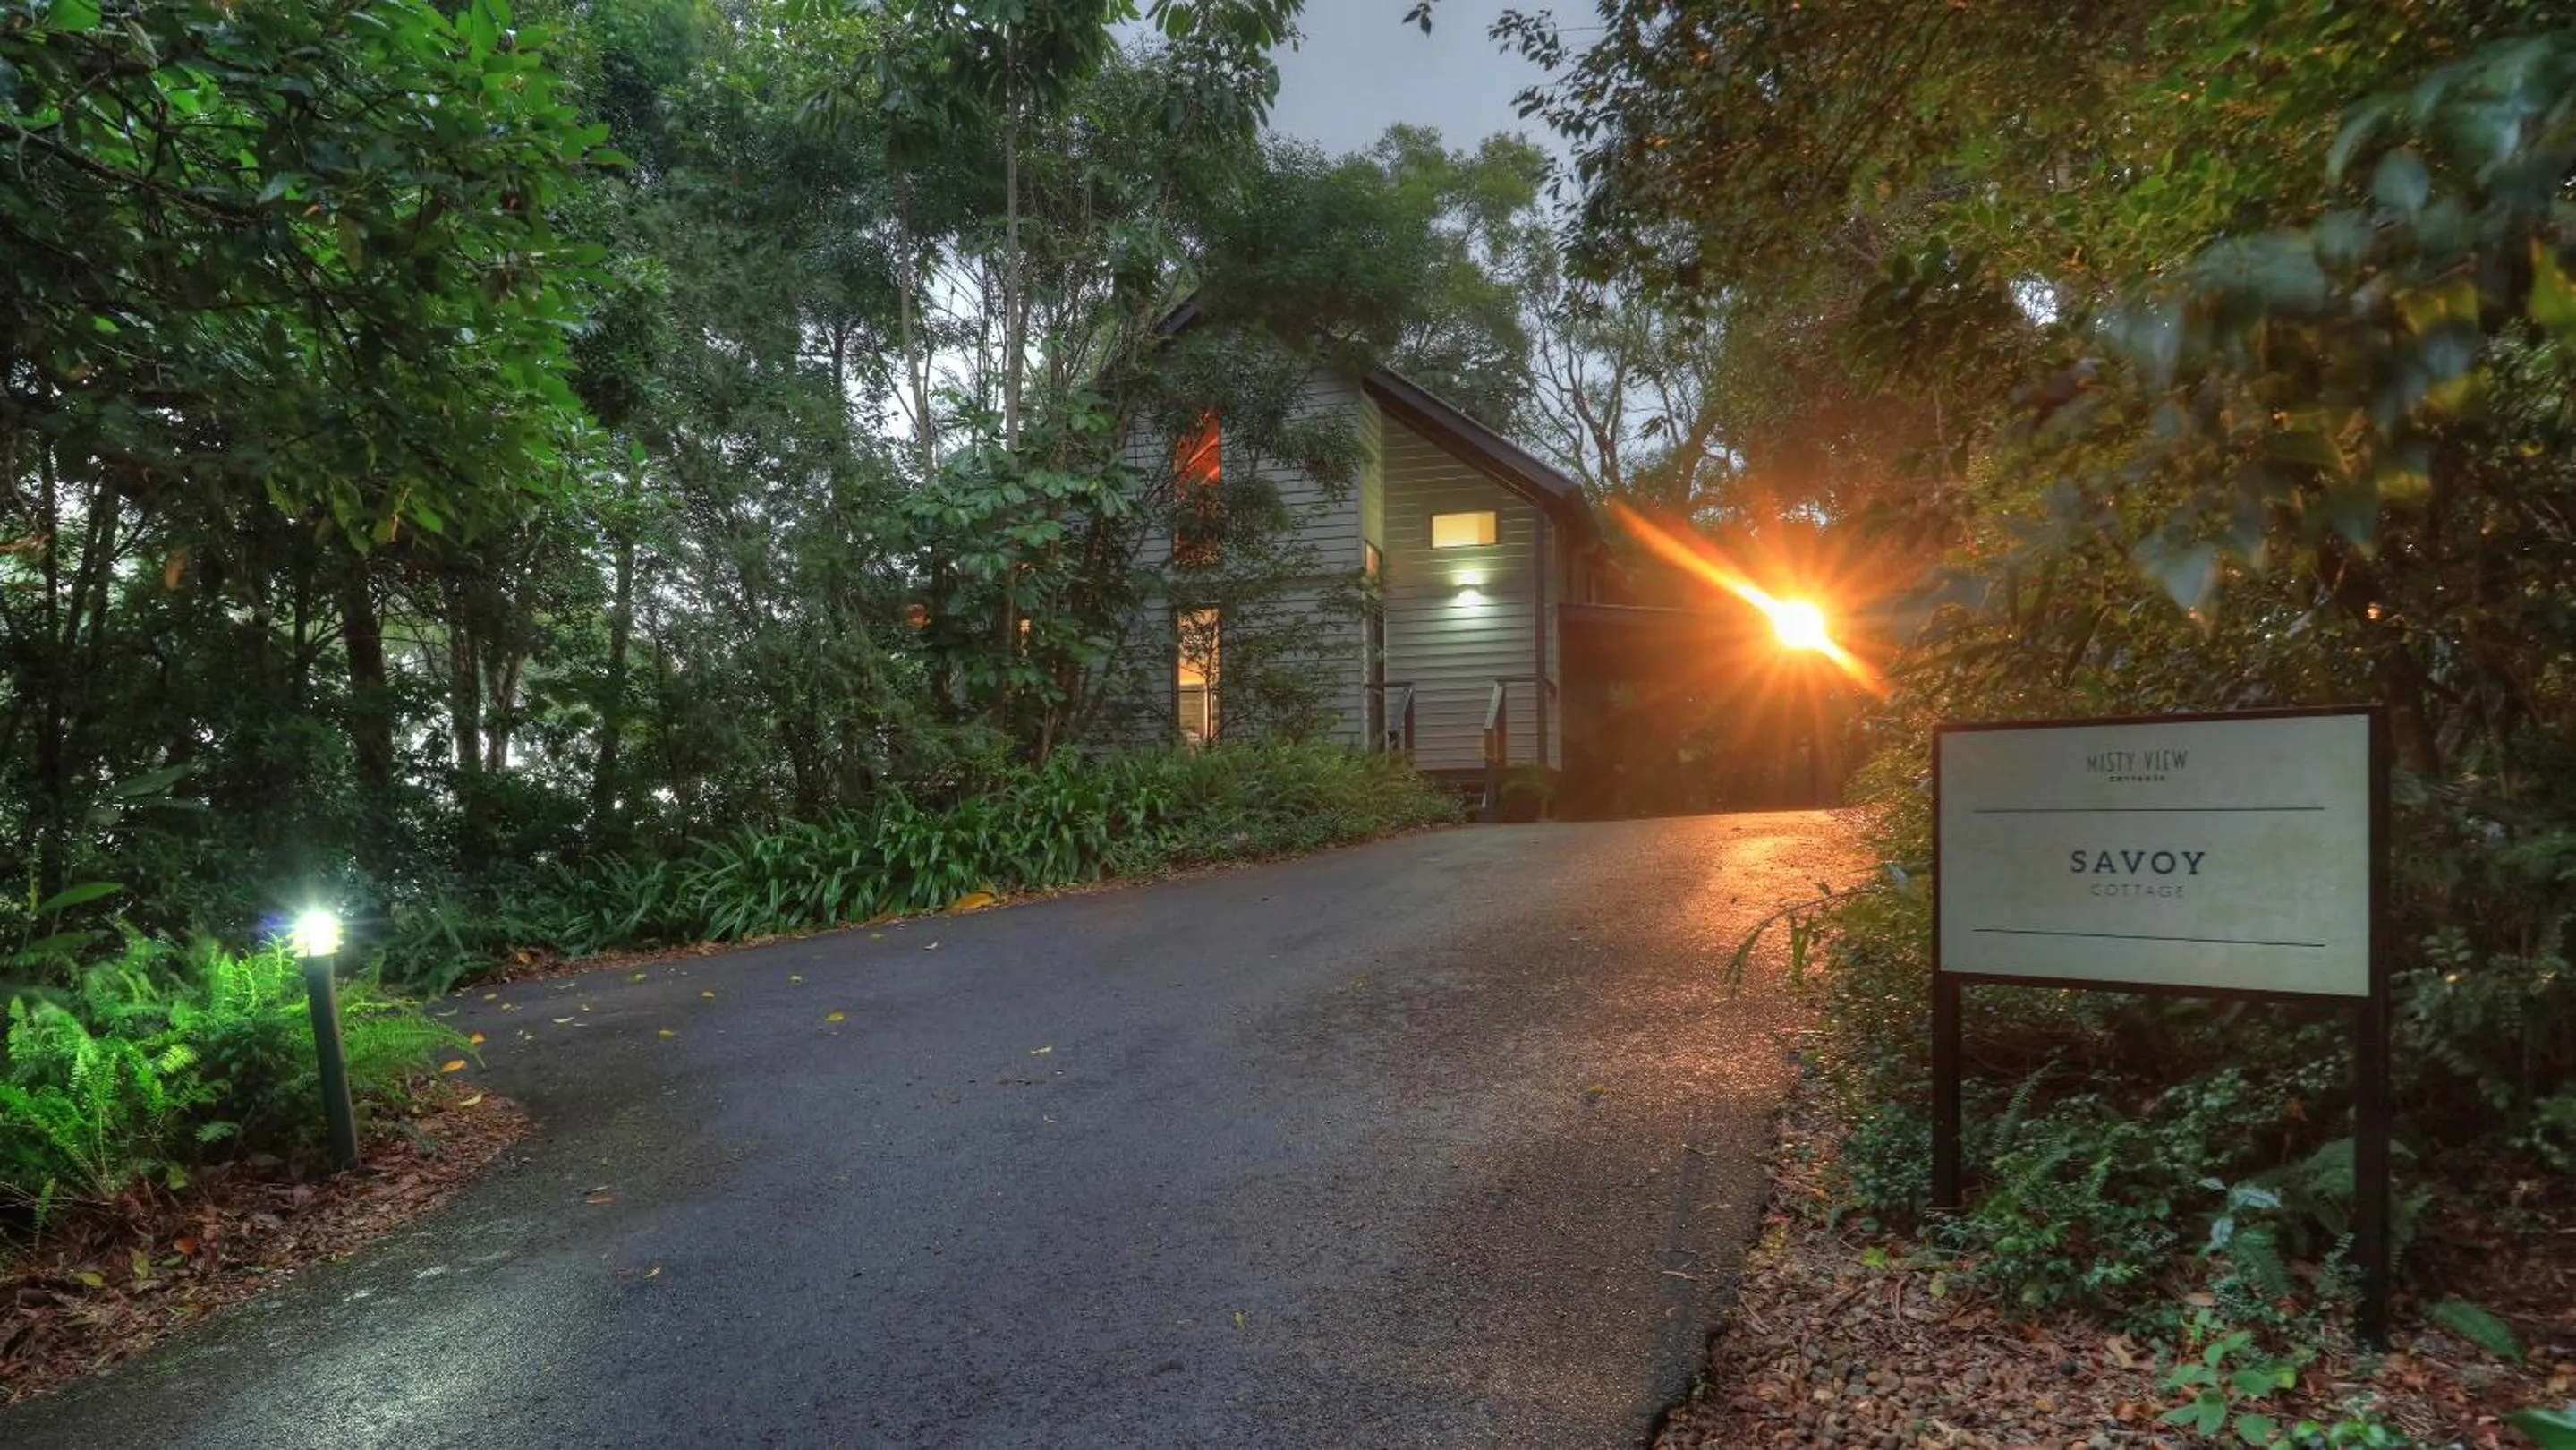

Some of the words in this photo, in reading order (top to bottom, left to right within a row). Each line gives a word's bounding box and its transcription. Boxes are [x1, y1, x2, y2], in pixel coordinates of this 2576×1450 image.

[2087, 751, 2136, 772] MISTY
[2145, 750, 2189, 772] VIEW
[2070, 850, 2206, 875] SAVOY
[2090, 883, 2185, 899] COTTAGE
